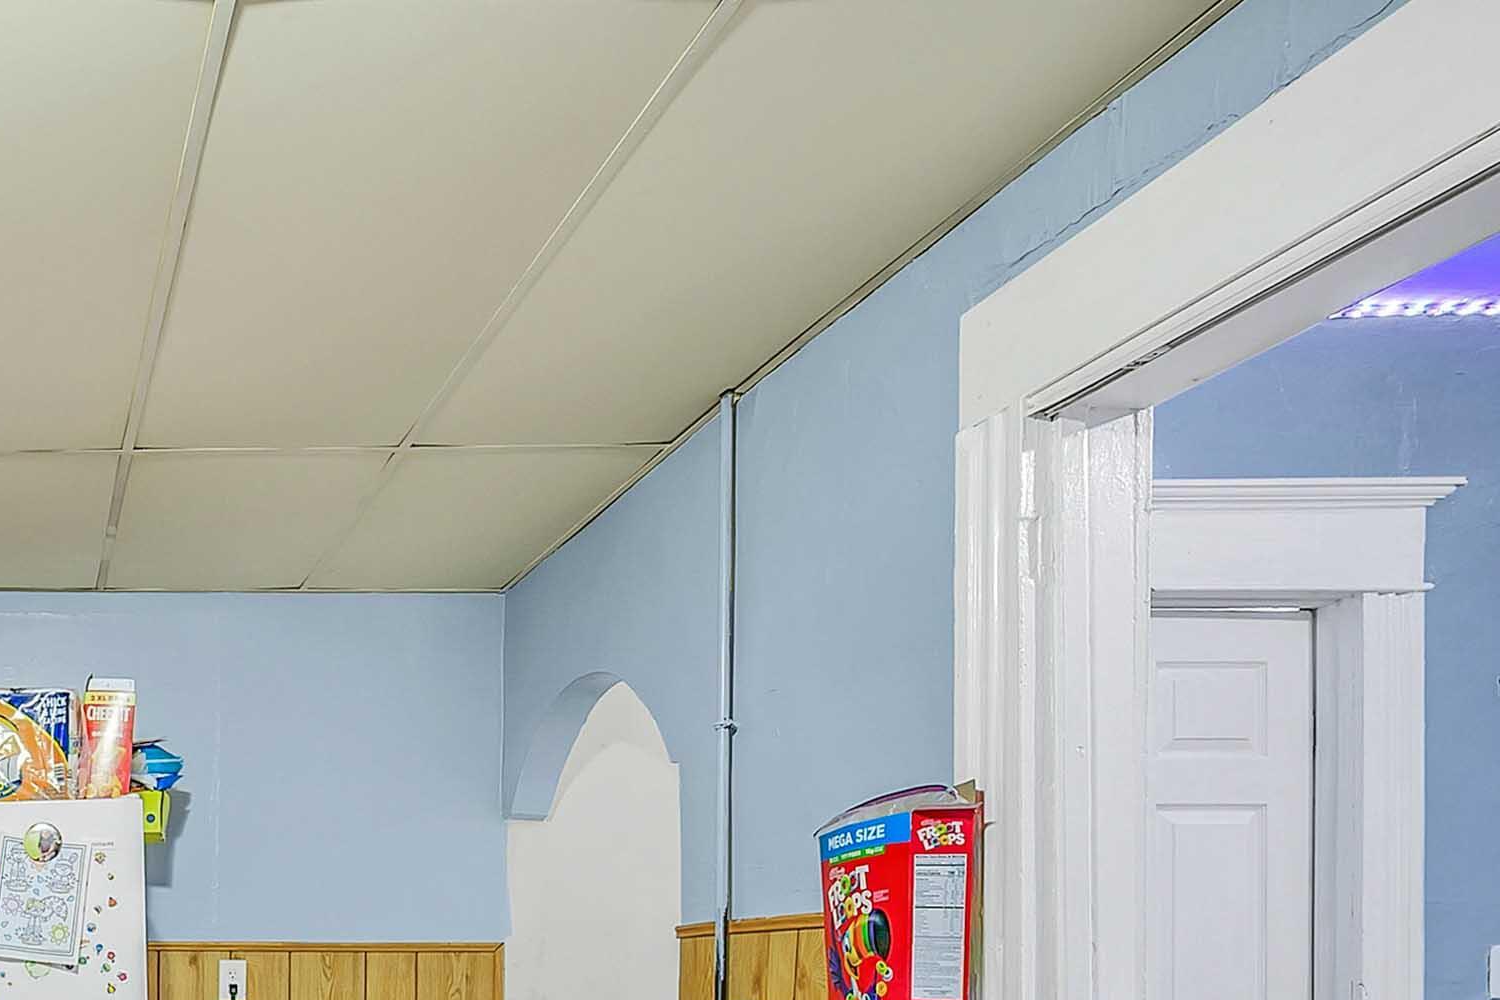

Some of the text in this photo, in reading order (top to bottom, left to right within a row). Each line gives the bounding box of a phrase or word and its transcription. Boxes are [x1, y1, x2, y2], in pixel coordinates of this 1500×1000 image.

[828, 824, 886, 851] MEGA SIZE
[917, 821, 963, 842] FROOT
[923, 833, 965, 850] LOOPS
[828, 864, 869, 912] FROOT
[833, 890, 873, 929] LOOPS
